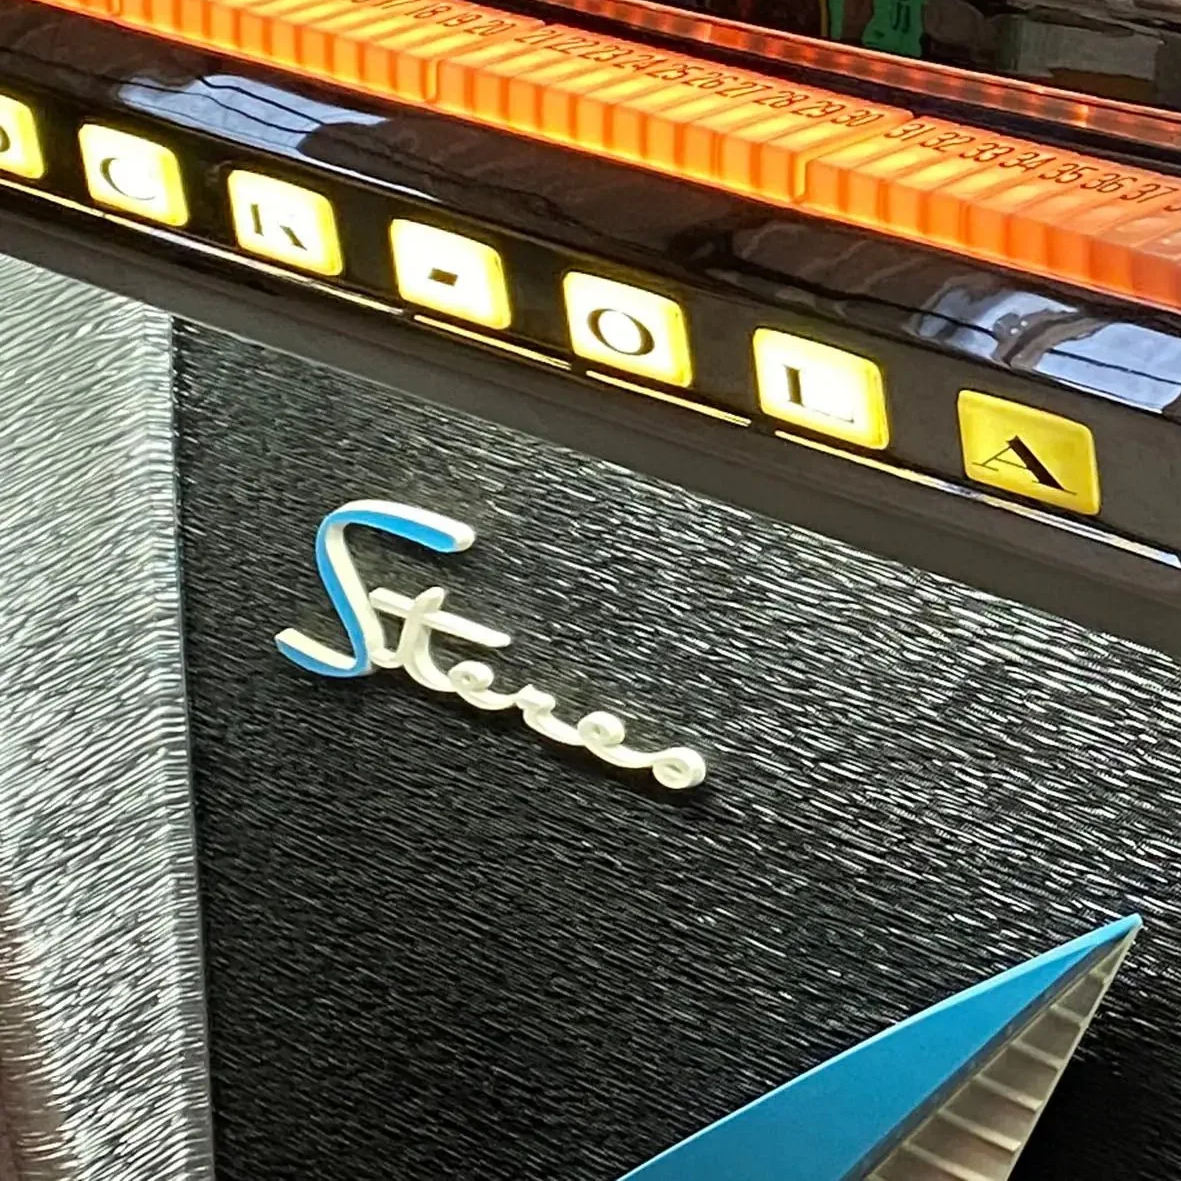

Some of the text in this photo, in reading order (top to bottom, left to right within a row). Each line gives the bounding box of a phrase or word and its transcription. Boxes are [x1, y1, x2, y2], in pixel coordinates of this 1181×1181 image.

[404, 3, 452, 19] 18
[435, 11, 483, 27] 19
[464, 19, 516, 36] 20
[514, 30, 564, 45] 21
[543, 36, 600, 54] 22
[578, 45, 634, 62] 23
[612, 54, 668, 70] 24
[646, 63, 704, 80] 25
[681, 72, 738, 90] 26
[715, 81, 773, 98] 27
[752, 90, 808, 108] 28
[789, 100, 846, 119] 29
[830, 109, 884, 127] 30
[884, 123, 936, 141] 31
[919, 131, 976, 152] 32
[959, 142, 1015, 163] 33
[998, 151, 1056, 173] 34
[1038, 163, 1099, 184] 35
[1080, 172, 1138, 194] 36
[1120, 183, 1179, 203] 37
[275, 499, 707, 790] Stereo
